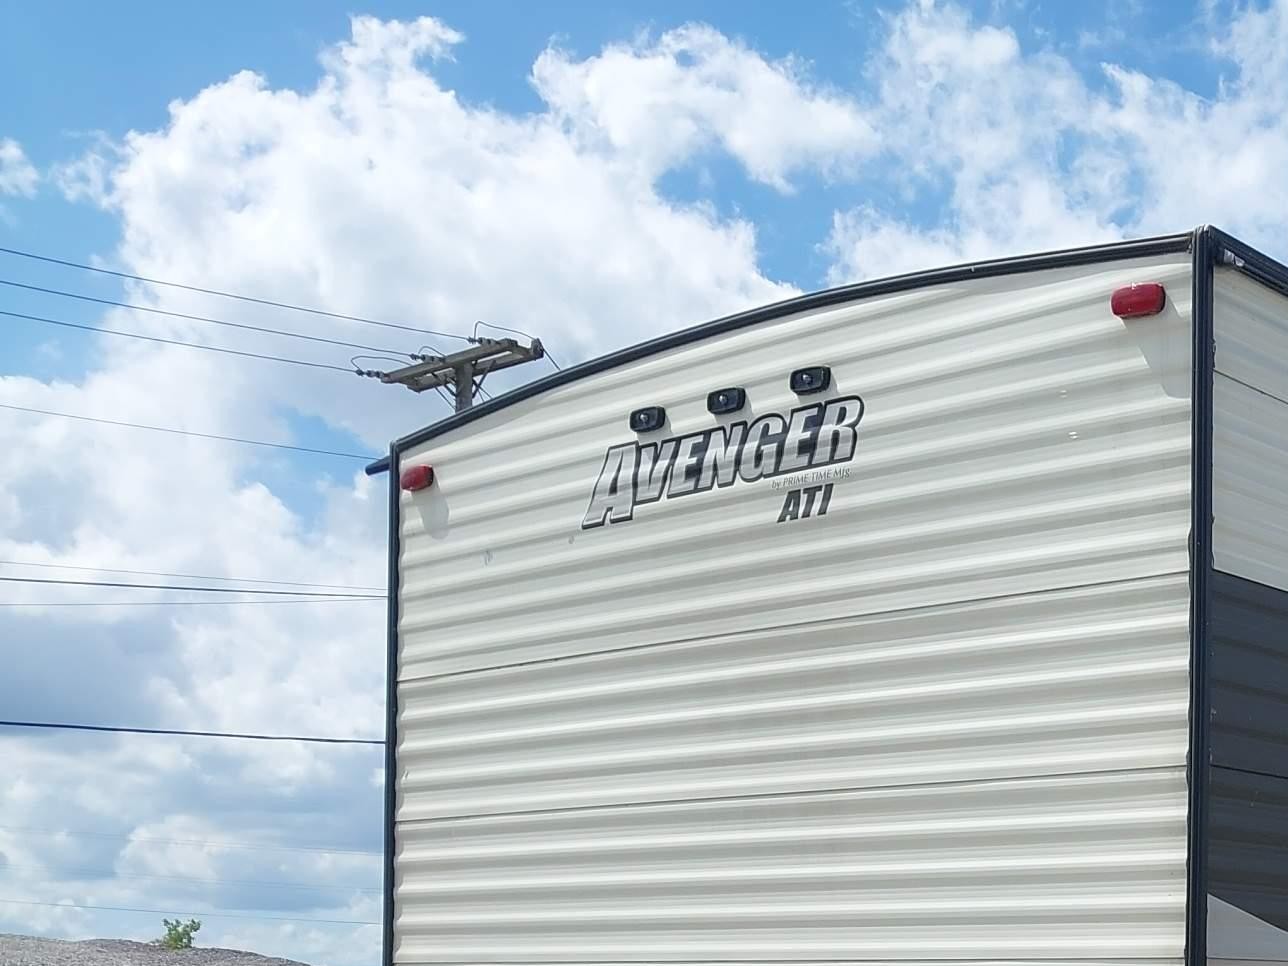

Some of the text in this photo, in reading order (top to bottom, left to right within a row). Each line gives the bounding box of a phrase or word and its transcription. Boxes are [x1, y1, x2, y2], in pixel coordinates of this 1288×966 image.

[581, 394, 865, 530] AVENGER
[783, 473, 809, 487] PRIME
[811, 470, 832, 481] TIME
[776, 483, 834, 523] ATI
